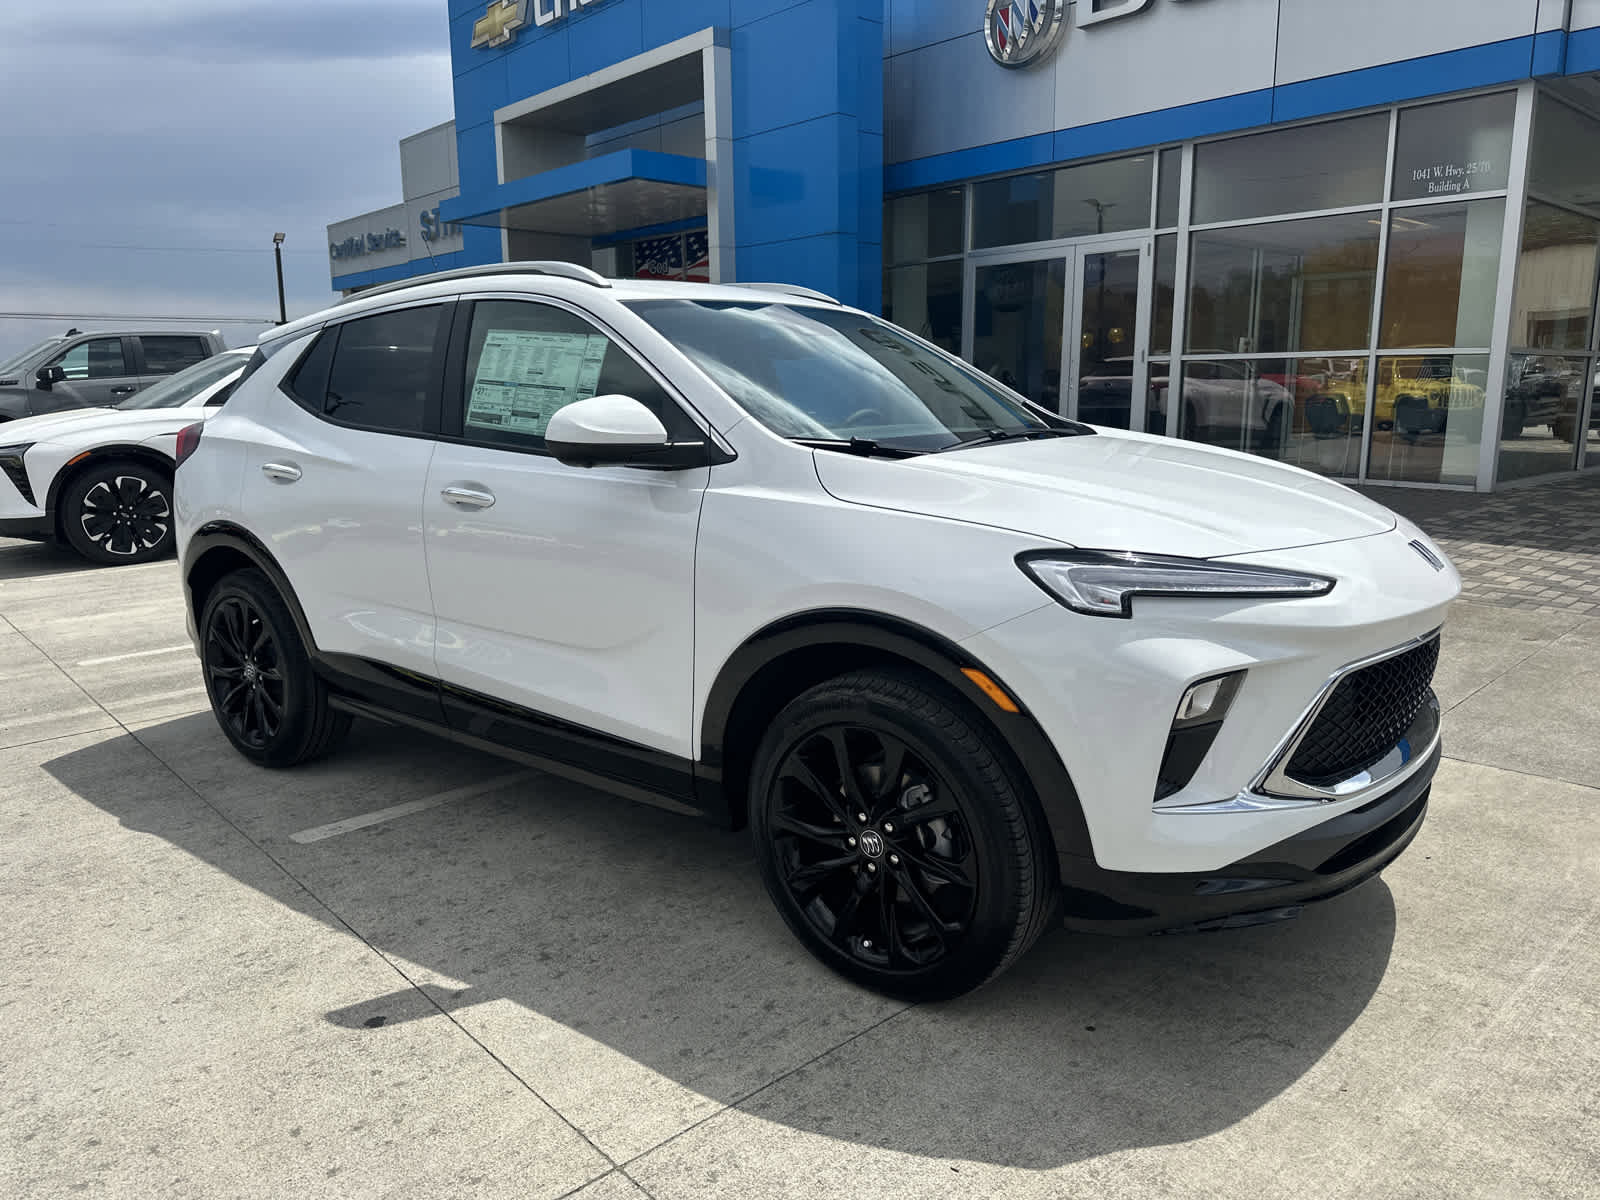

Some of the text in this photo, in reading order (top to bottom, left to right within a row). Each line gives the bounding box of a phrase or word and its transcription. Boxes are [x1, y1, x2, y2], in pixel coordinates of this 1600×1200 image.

[1412, 168, 1430, 180] 1041
[1433, 166, 1443, 177] W.
[1445, 164, 1465, 177] Hwy.
[1428, 178, 1470, 193] Building A
[648, 257, 670, 274] God
